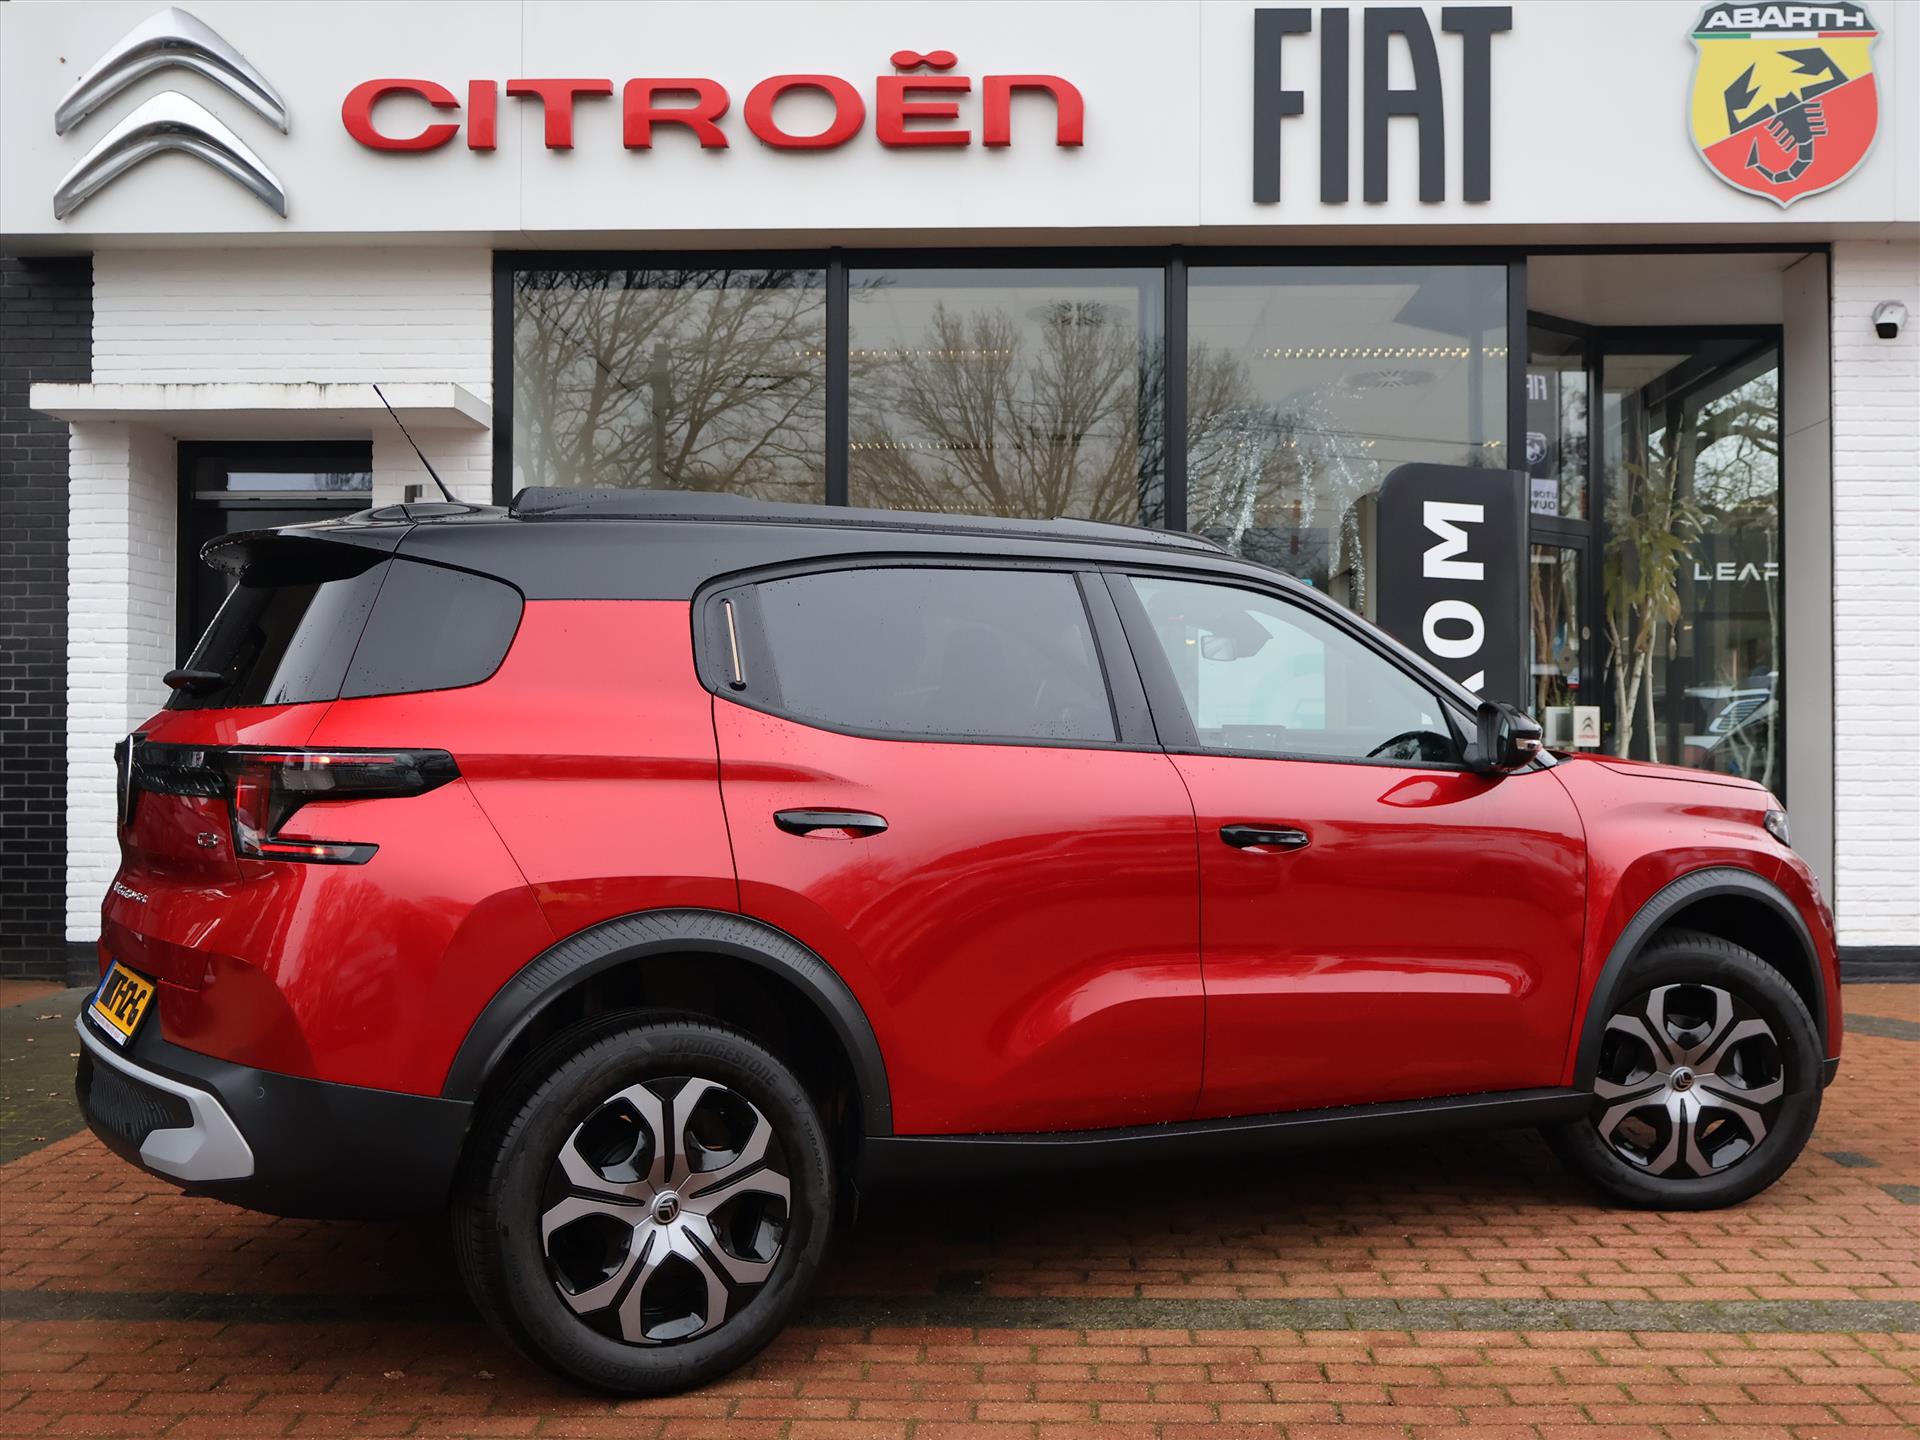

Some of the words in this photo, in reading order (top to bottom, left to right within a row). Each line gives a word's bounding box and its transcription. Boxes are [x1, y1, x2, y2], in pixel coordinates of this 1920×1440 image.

[1705, 6, 1864, 29] ABARTH
[342, 50, 1084, 153] CITROËN
[1253, 6, 1513, 204] FIAT
[1422, 501, 1485, 693] OM
[671, 1037, 780, 1087] BRIDGESTONE
